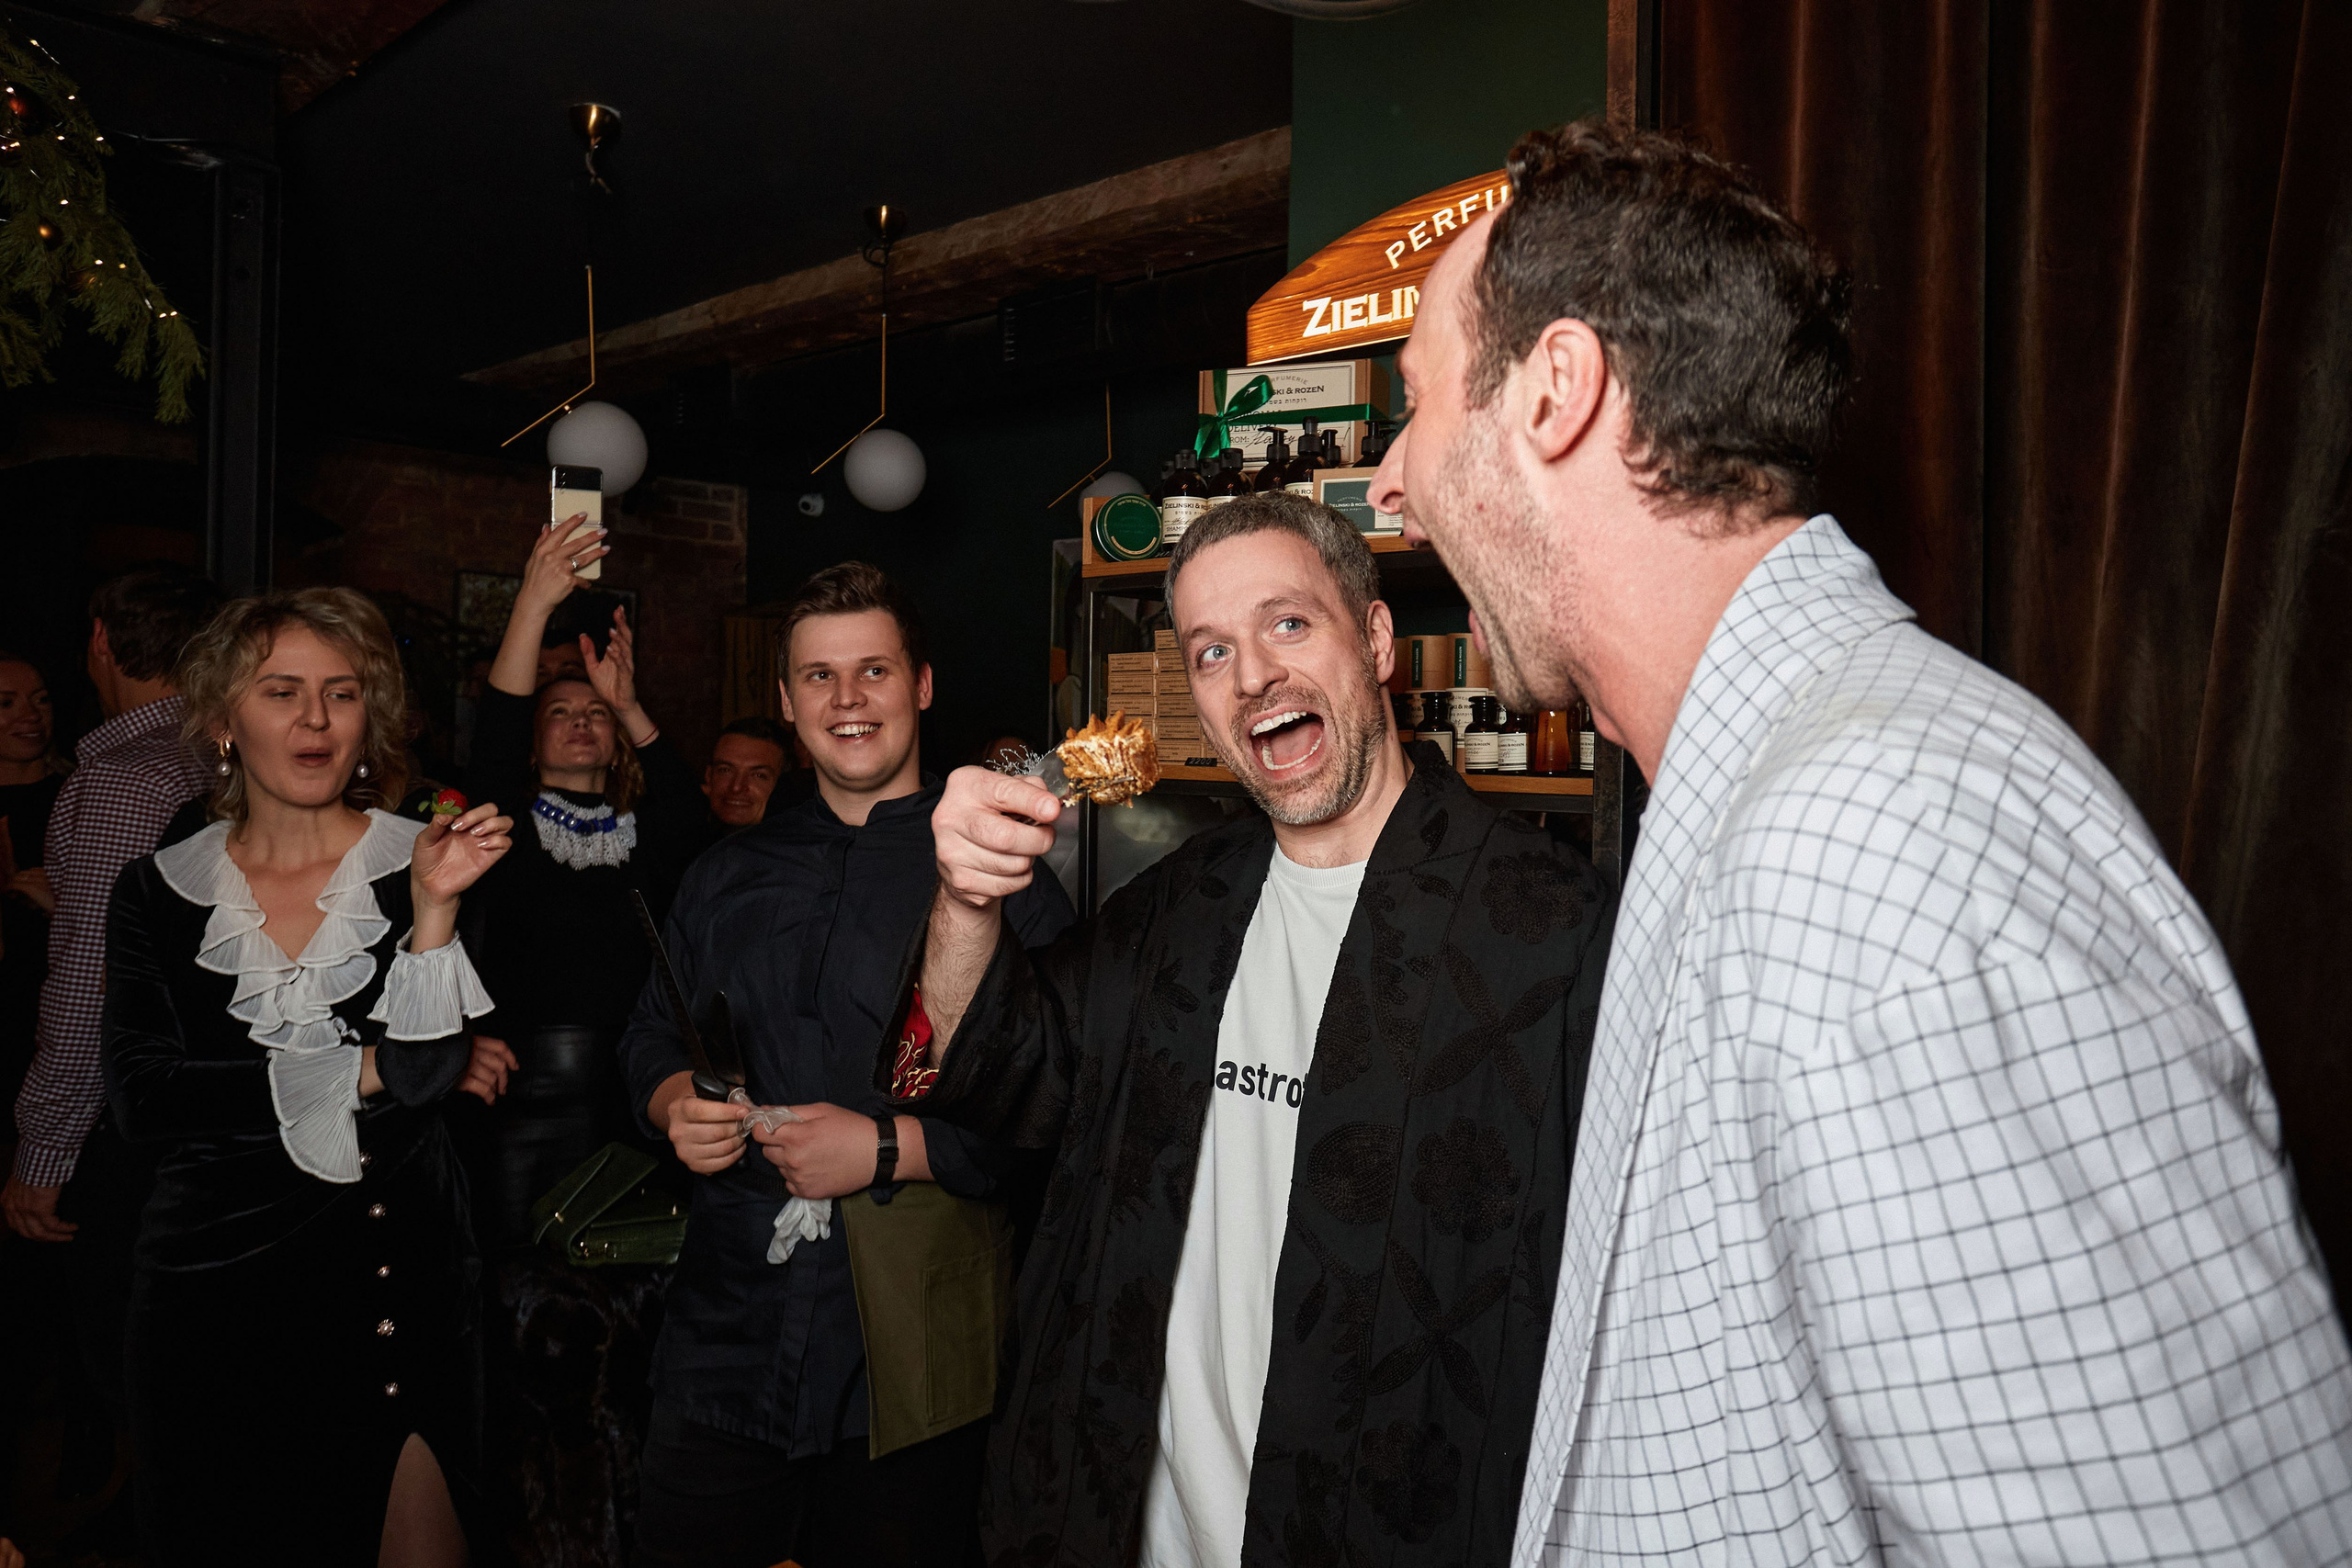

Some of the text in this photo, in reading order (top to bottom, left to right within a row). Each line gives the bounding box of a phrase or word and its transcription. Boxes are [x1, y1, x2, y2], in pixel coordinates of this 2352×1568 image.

[1286, 387, 1294, 395] &
[1295, 385, 1325, 394] ROZEN
[1189, 757, 1212, 765] 2200
